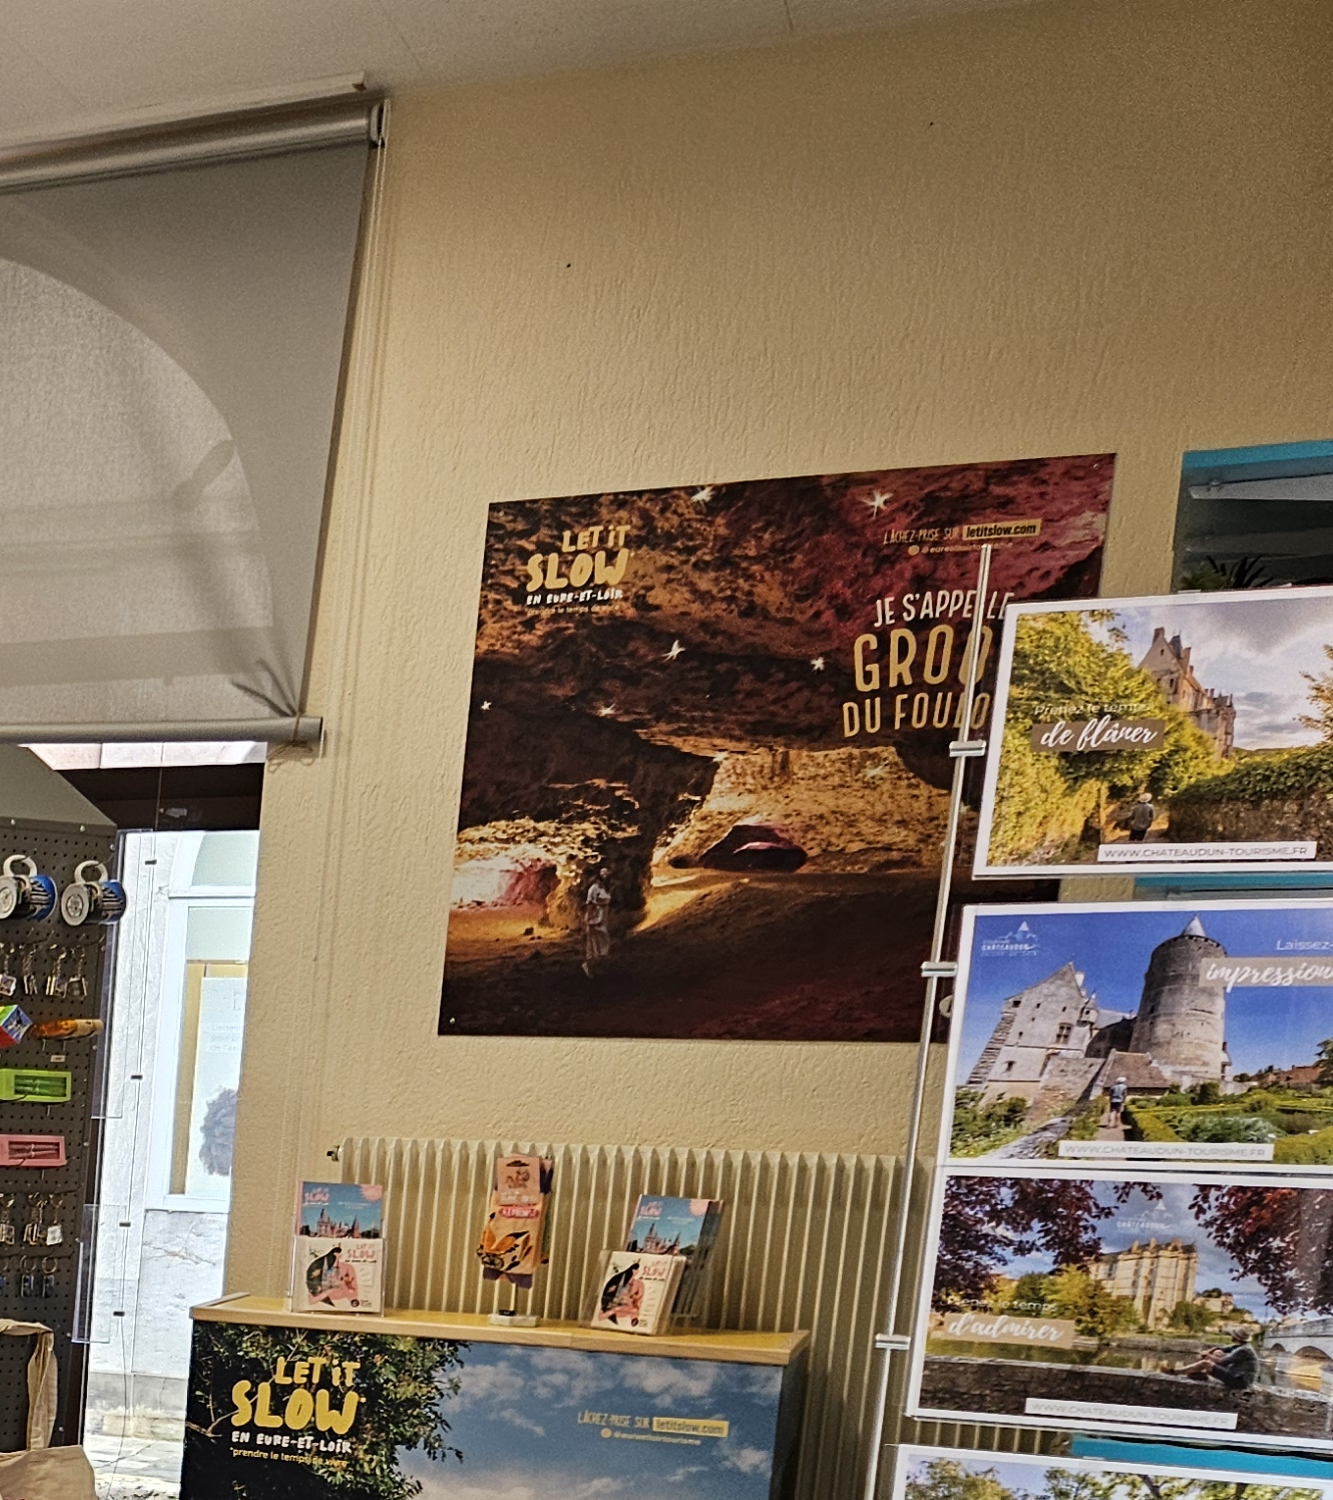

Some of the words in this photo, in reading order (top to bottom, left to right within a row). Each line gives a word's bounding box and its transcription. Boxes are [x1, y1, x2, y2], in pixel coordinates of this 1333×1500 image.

[561, 525, 604, 552] LET
[943, 526, 960, 541] SUR
[966, 523, 1037, 539] letitslow.com
[525, 547, 630, 592] SLOW
[526, 594, 542, 606] EN
[873, 596, 896, 628] JE
[902, 589, 1015, 622] S'APPELE
[853, 623, 994, 692] GROO
[842, 697, 882, 738] DU
[894, 691, 991, 730] FOULO
[1034, 704, 1083, 716] Prenez
[1086, 702, 1101, 714] le
[1103, 702, 1151, 713] temps
[1039, 720, 1075, 748] de
[1076, 714, 1159, 752] flâner
[1103, 846, 1308, 858] WWW.CHATEAUDUN-TOURISME.FR
[947, 1311, 1064, 1342] d'admirer
[274, 1356, 327, 1385] LET
[230, 1379, 360, 1435] SLOW
[231, 1430, 251, 1443] EN
[656, 1419, 725, 1435] letitslow.com
